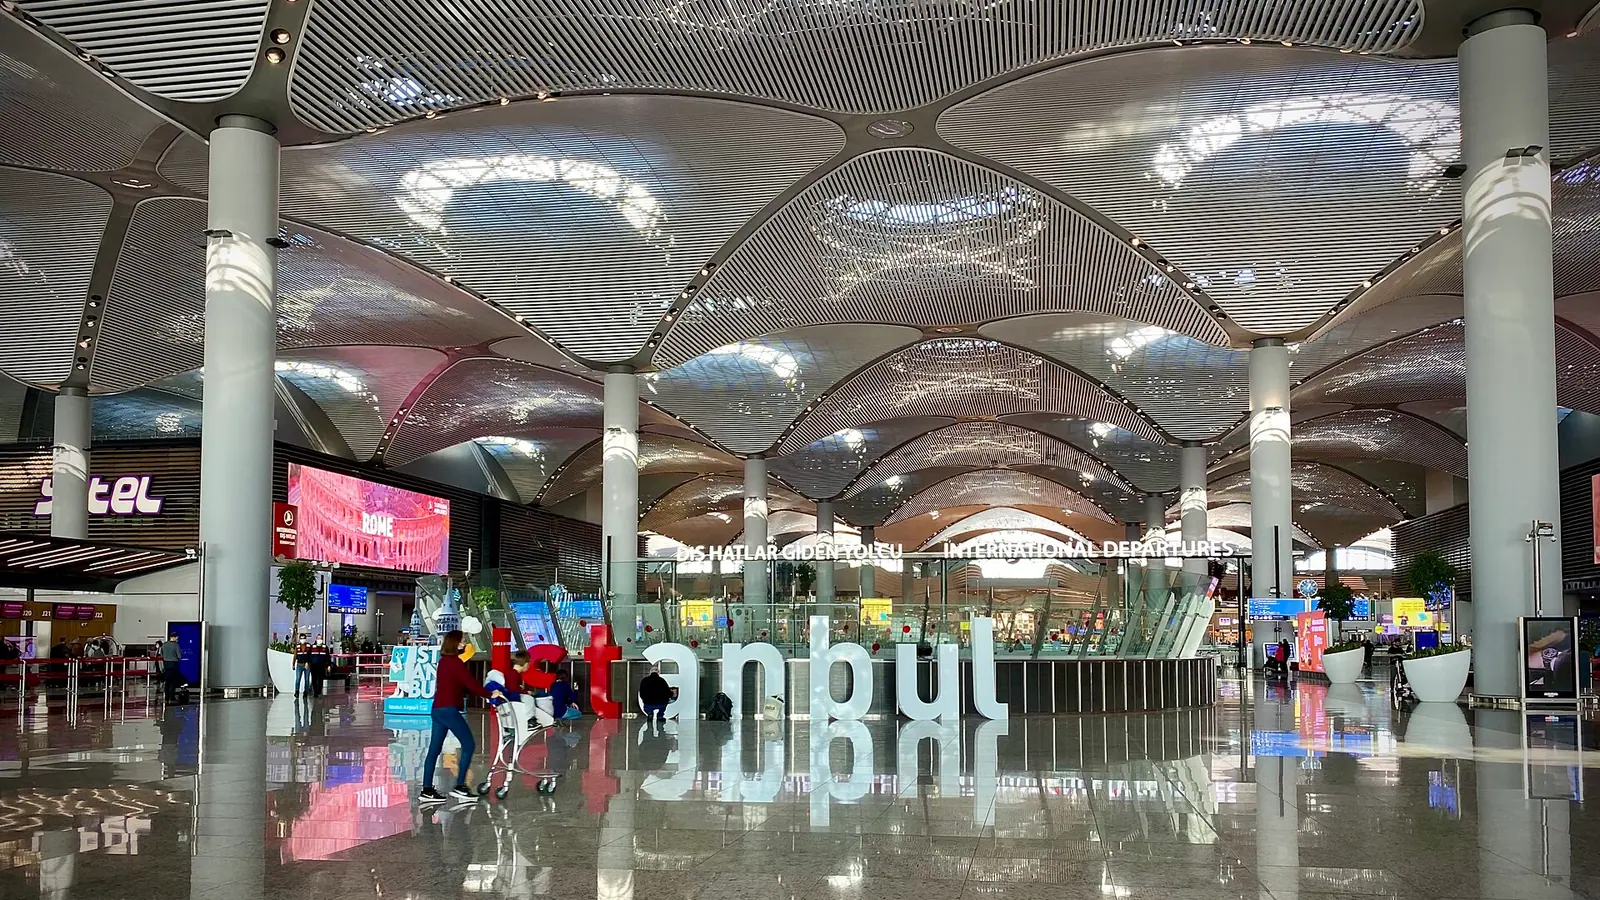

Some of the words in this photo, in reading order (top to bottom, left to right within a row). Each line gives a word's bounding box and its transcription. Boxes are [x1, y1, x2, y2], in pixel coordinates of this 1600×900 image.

[34, 475, 163, 515] tel
[362, 511, 394, 538] ROME
[709, 544, 778, 561] HATLAR
[843, 542, 903, 560] YOLCU
[943, 541, 1099, 559] INTERNATIONAL
[1103, 540, 1234, 558] DEPARTURES
[408, 680, 437, 698] BU
